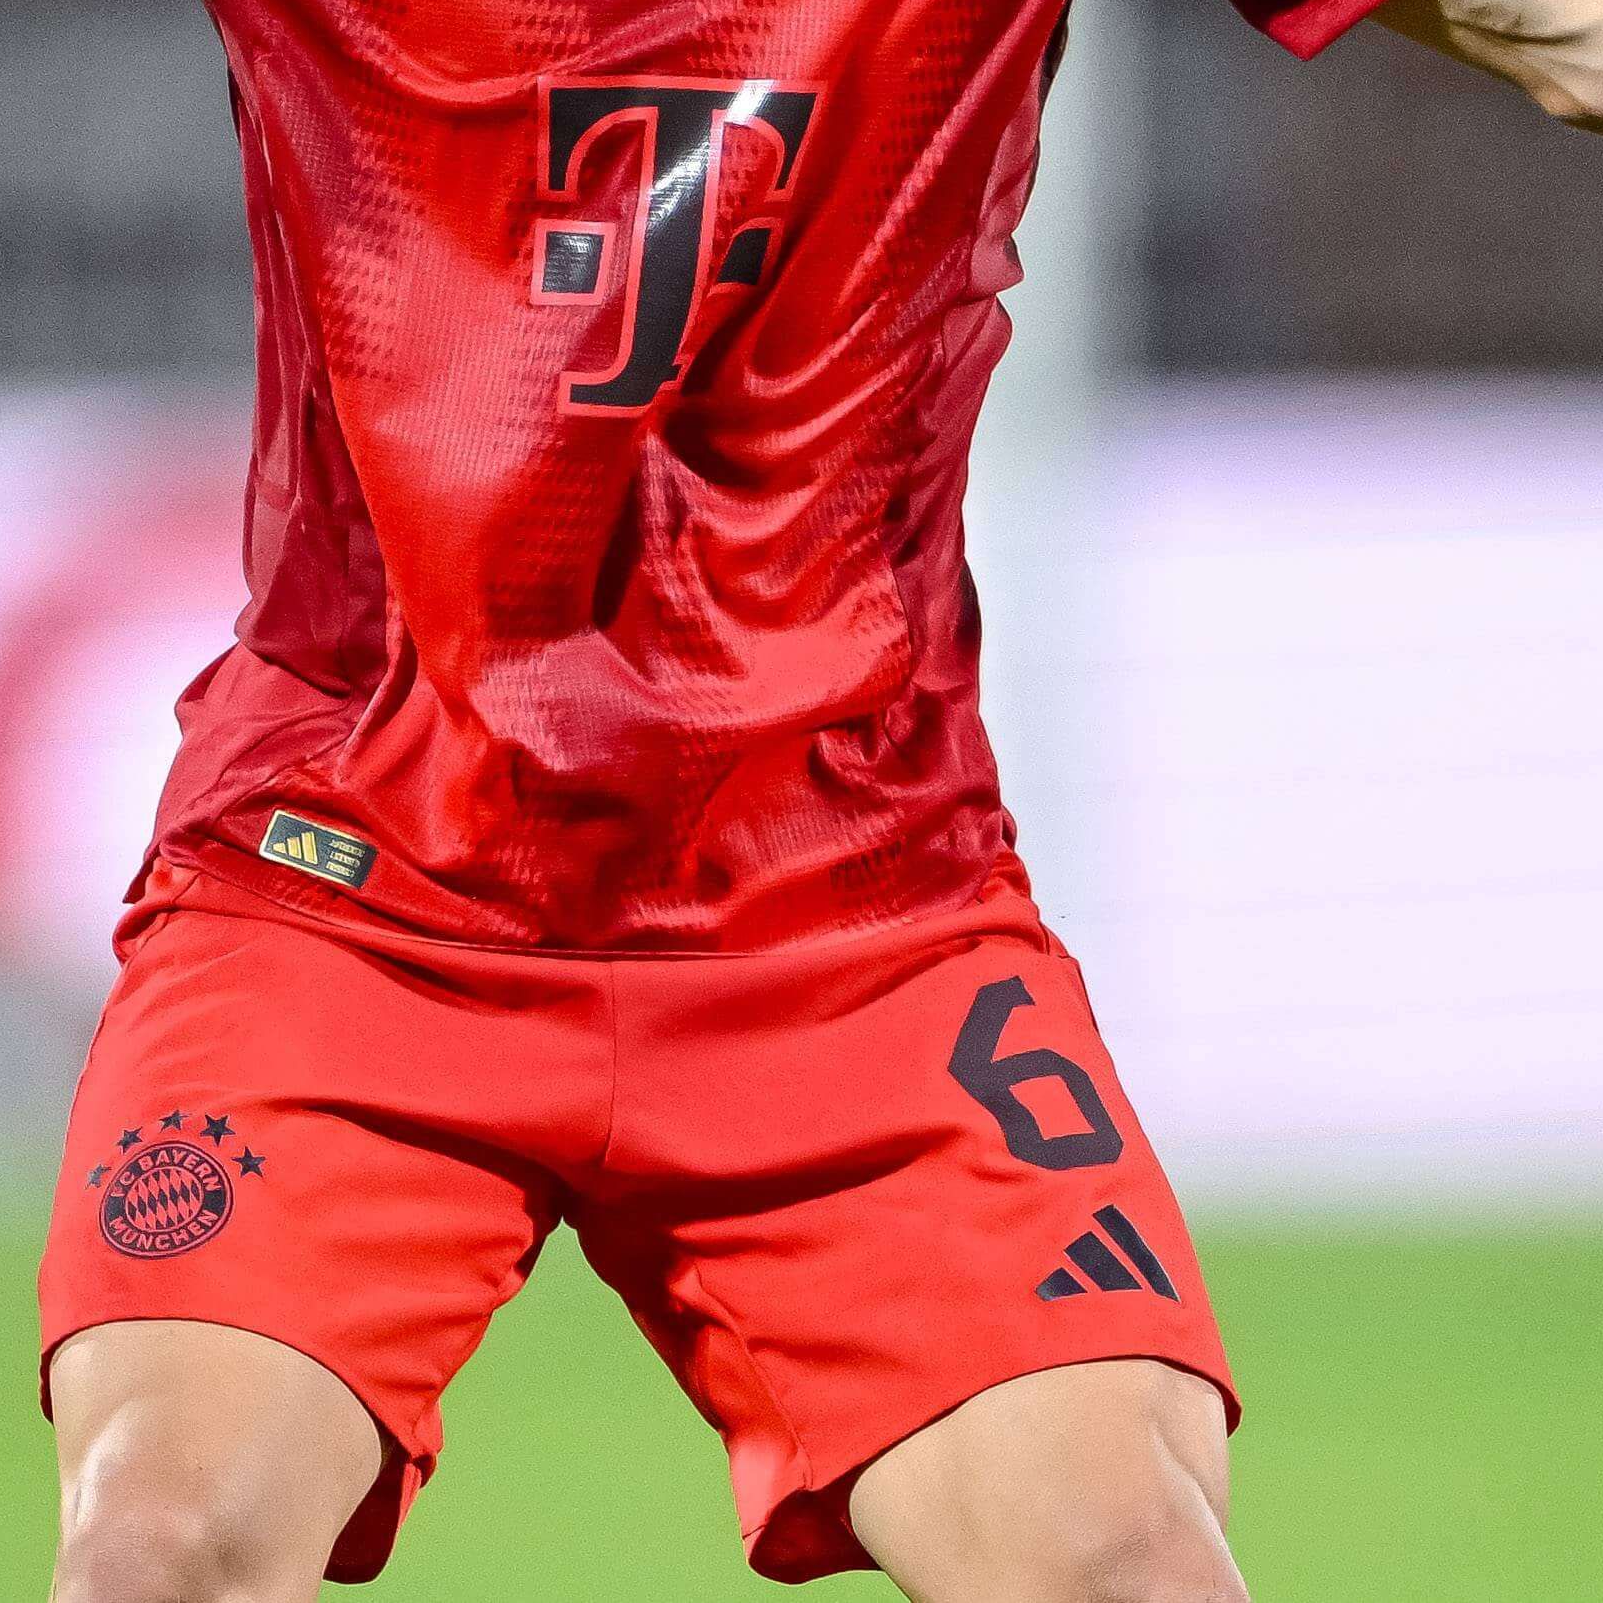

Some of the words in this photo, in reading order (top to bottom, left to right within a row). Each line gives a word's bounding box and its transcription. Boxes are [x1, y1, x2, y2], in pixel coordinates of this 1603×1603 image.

[947, 975, 1125, 1171] 6
[110, 1171, 136, 1197] FC
[138, 1149, 222, 1192] BAYERN
